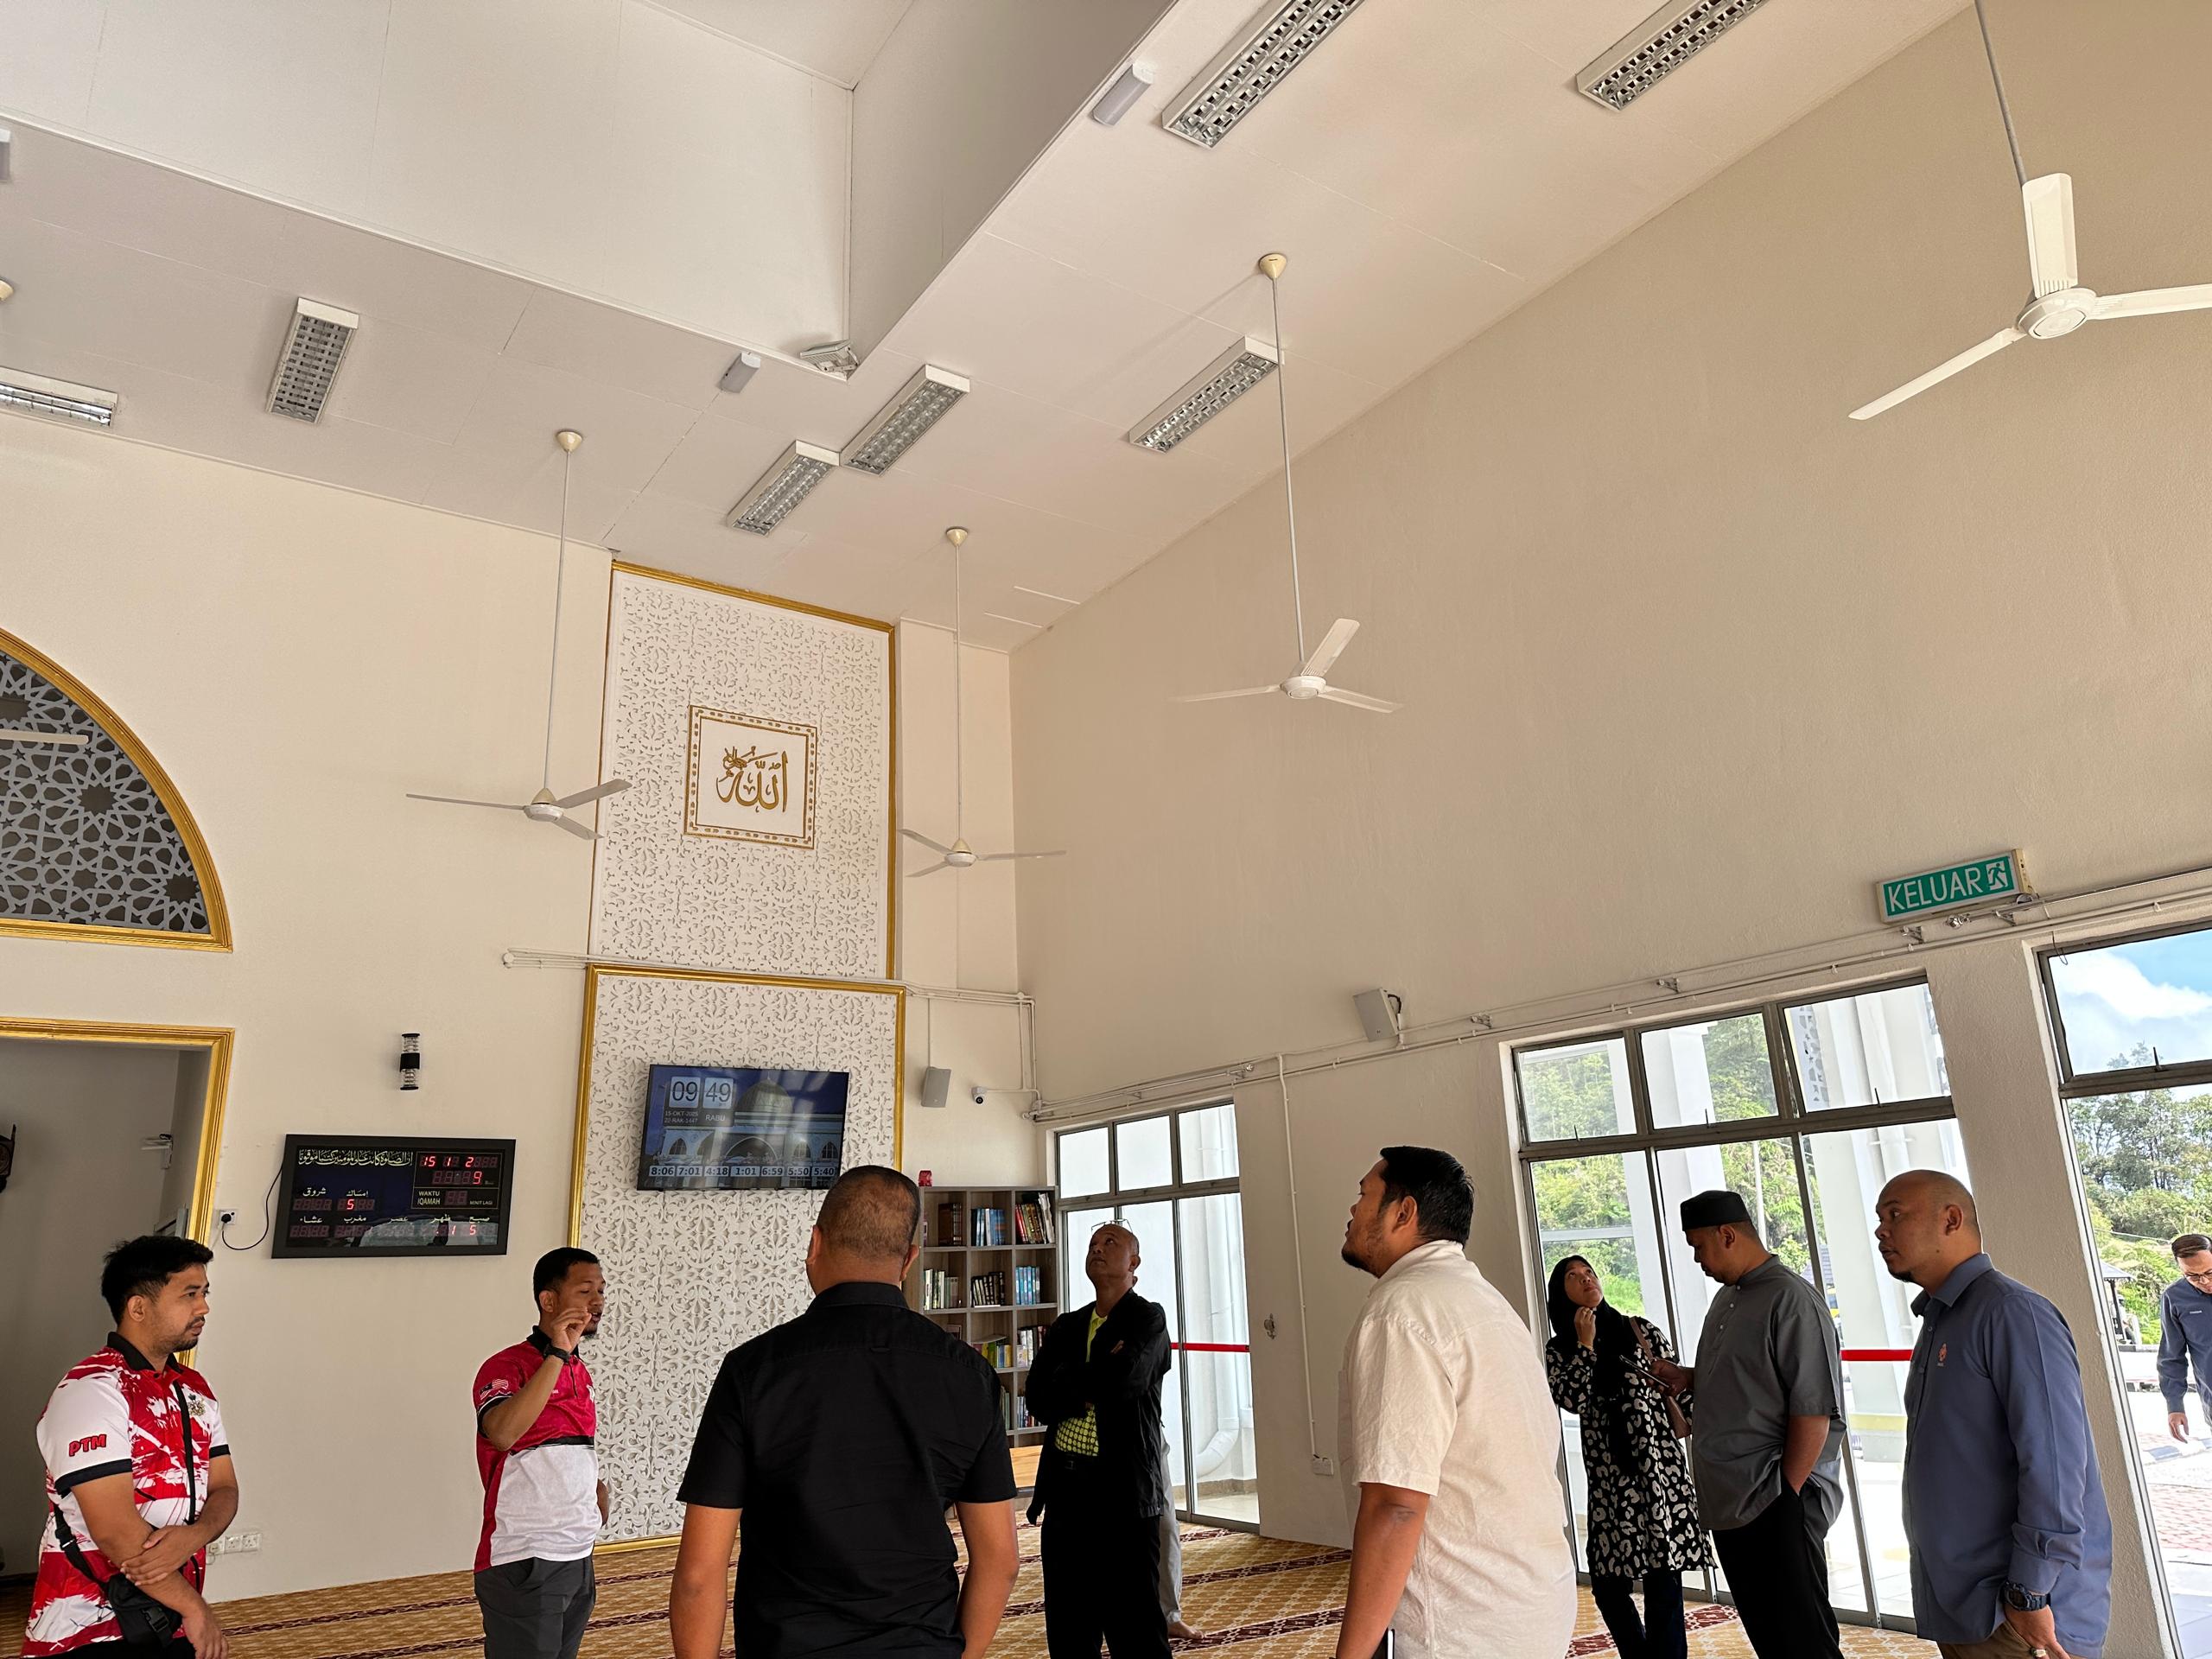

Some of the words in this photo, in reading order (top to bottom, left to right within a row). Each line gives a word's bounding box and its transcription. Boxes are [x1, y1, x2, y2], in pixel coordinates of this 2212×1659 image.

[1888, 867, 1984, 913] KELUAR
[672, 1081, 698, 1102] 09
[705, 1082, 731, 1103] 49
[423, 1156, 435, 1167] 15
[651, 1166, 674, 1176] 8:06
[678, 1166, 701, 1176] 7:01
[705, 1166, 728, 1176] 4:18
[735, 1166, 757, 1176] 1:01
[762, 1166, 784, 1176] 6:59
[787, 1166, 810, 1176] 5:50
[814, 1167, 835, 1176] 5:40
[302, 1187, 327, 1197] شروق
[299, 1215, 323, 1224] عشاء
[343, 1215, 367, 1224] مغرب
[68, 1433, 107, 1458] PTM
